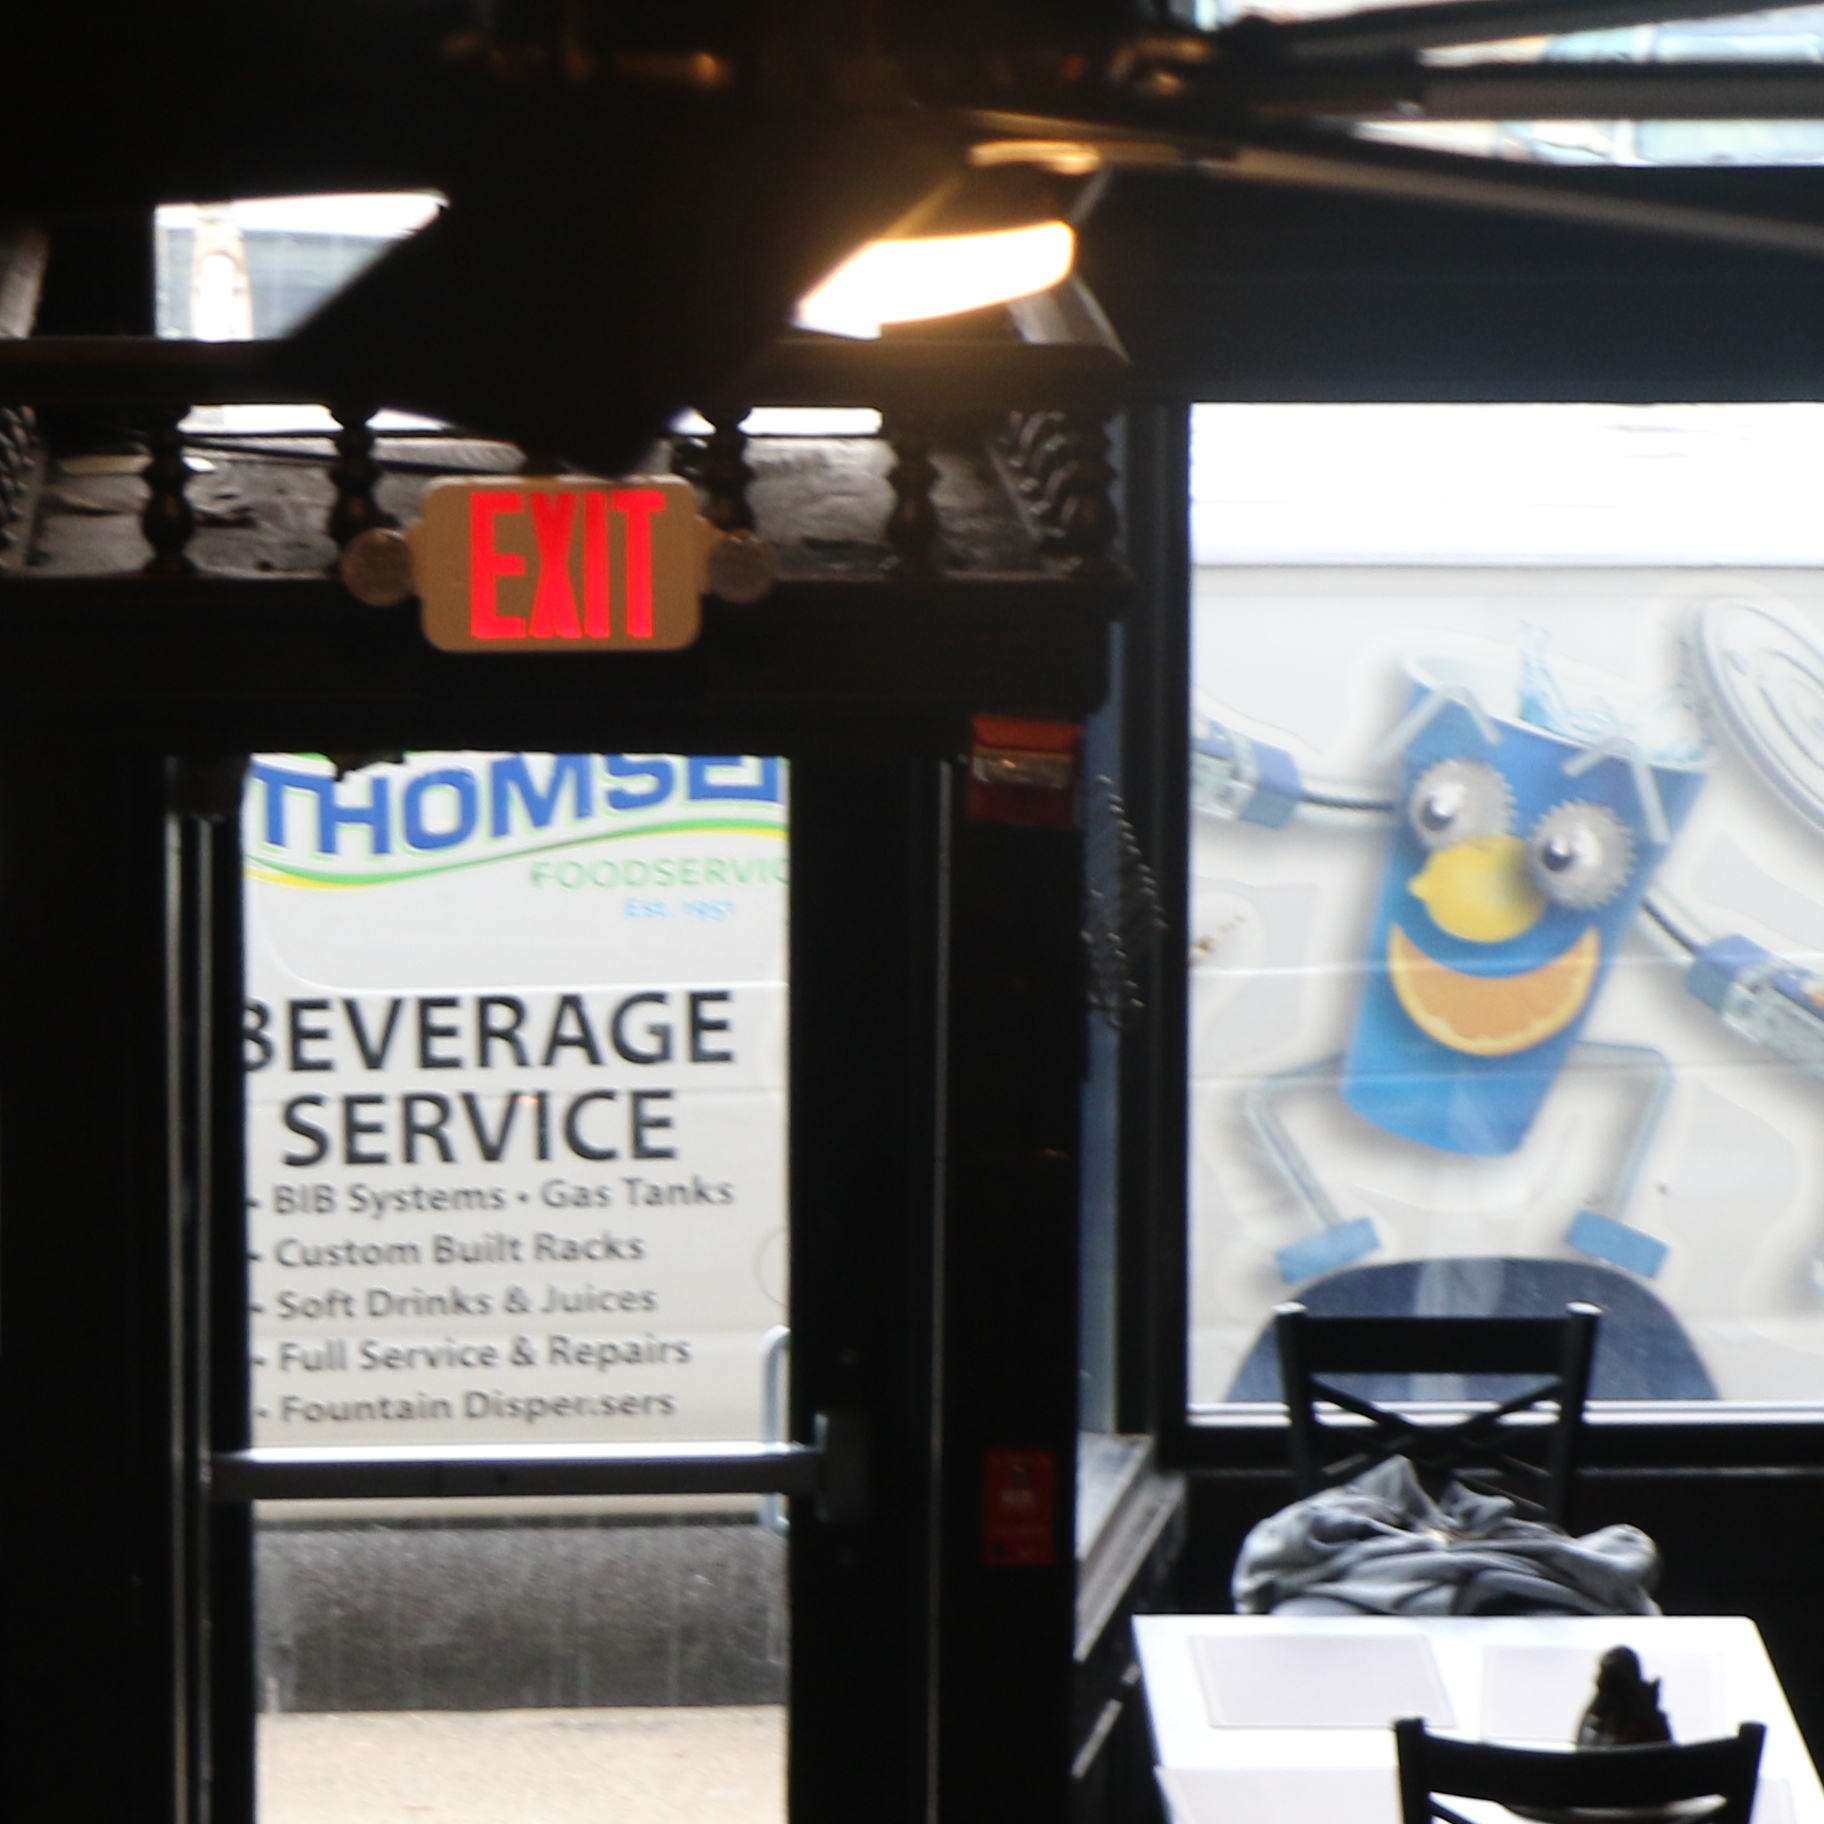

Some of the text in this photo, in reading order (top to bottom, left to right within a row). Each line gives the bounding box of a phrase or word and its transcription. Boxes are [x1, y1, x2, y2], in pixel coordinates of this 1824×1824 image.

[469, 489, 666, 639] EXIT
[250, 755, 778, 857] THOMSE
[243, 990, 736, 1072] BEVERAGE
[281, 1090, 678, 1166] SERVICE
[273, 1175, 735, 1220] BIB Systems Gas Tanks
[276, 1231, 646, 1267] Custom Built Racks
[277, 1284, 658, 1319] Soft Drinks & Juices
[280, 1332, 692, 1372] Full Service & Repairs
[281, 1392, 452, 1422] Fountain
